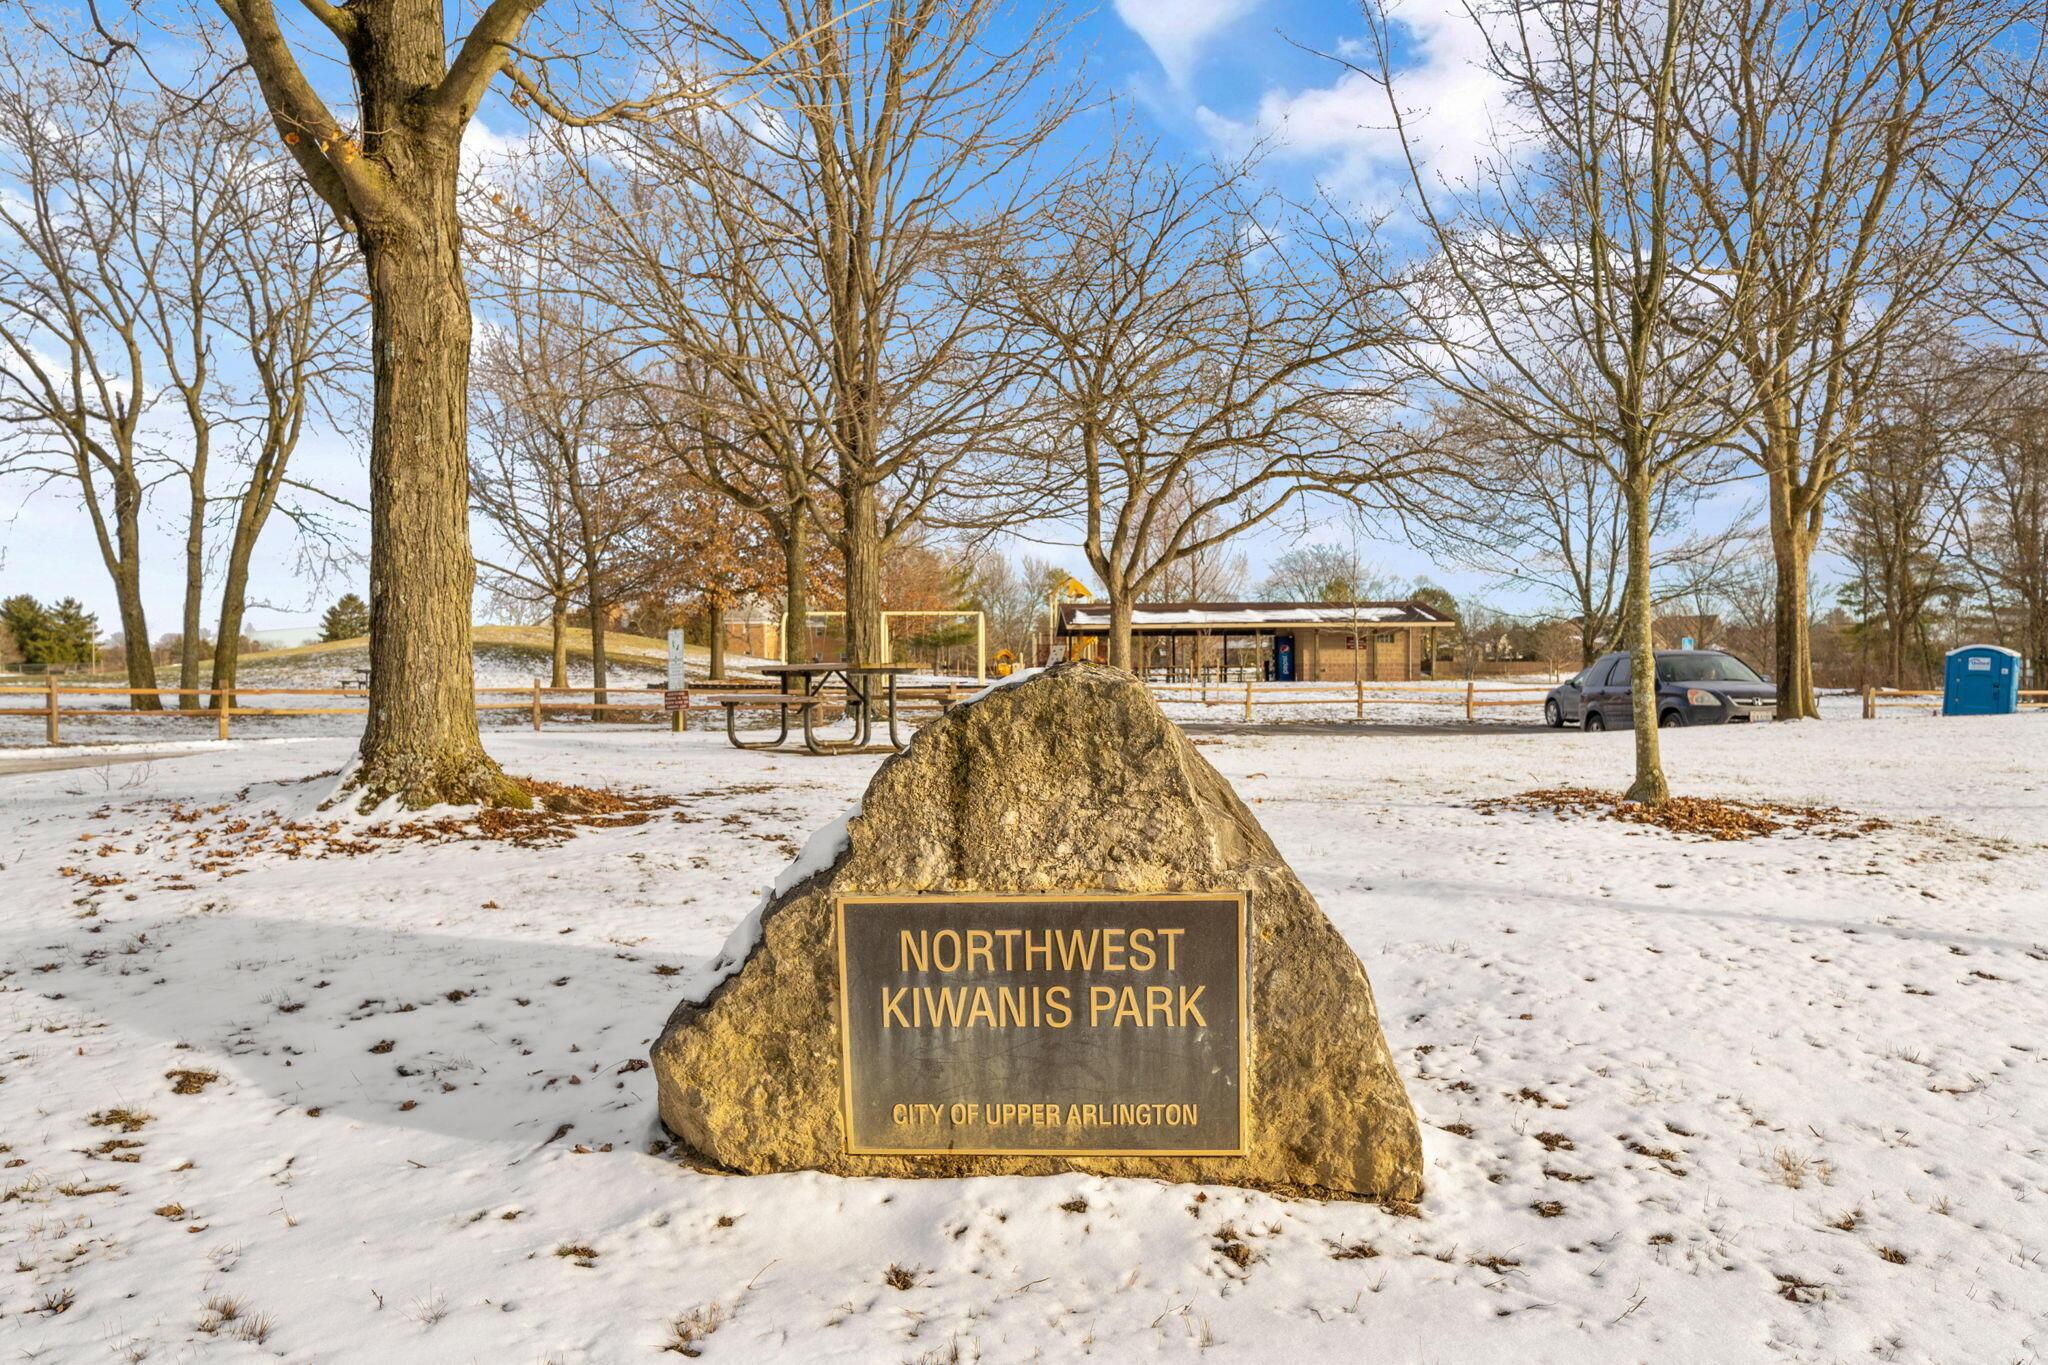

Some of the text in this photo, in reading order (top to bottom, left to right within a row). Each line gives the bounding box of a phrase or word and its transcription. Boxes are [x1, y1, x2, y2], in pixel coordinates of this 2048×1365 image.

[901, 929, 1185, 972] NORTHWEST
[882, 986, 1207, 1028] KIWANIS PARK
[892, 1103, 1198, 1126] CITY OF UPPER ARLINGTON
